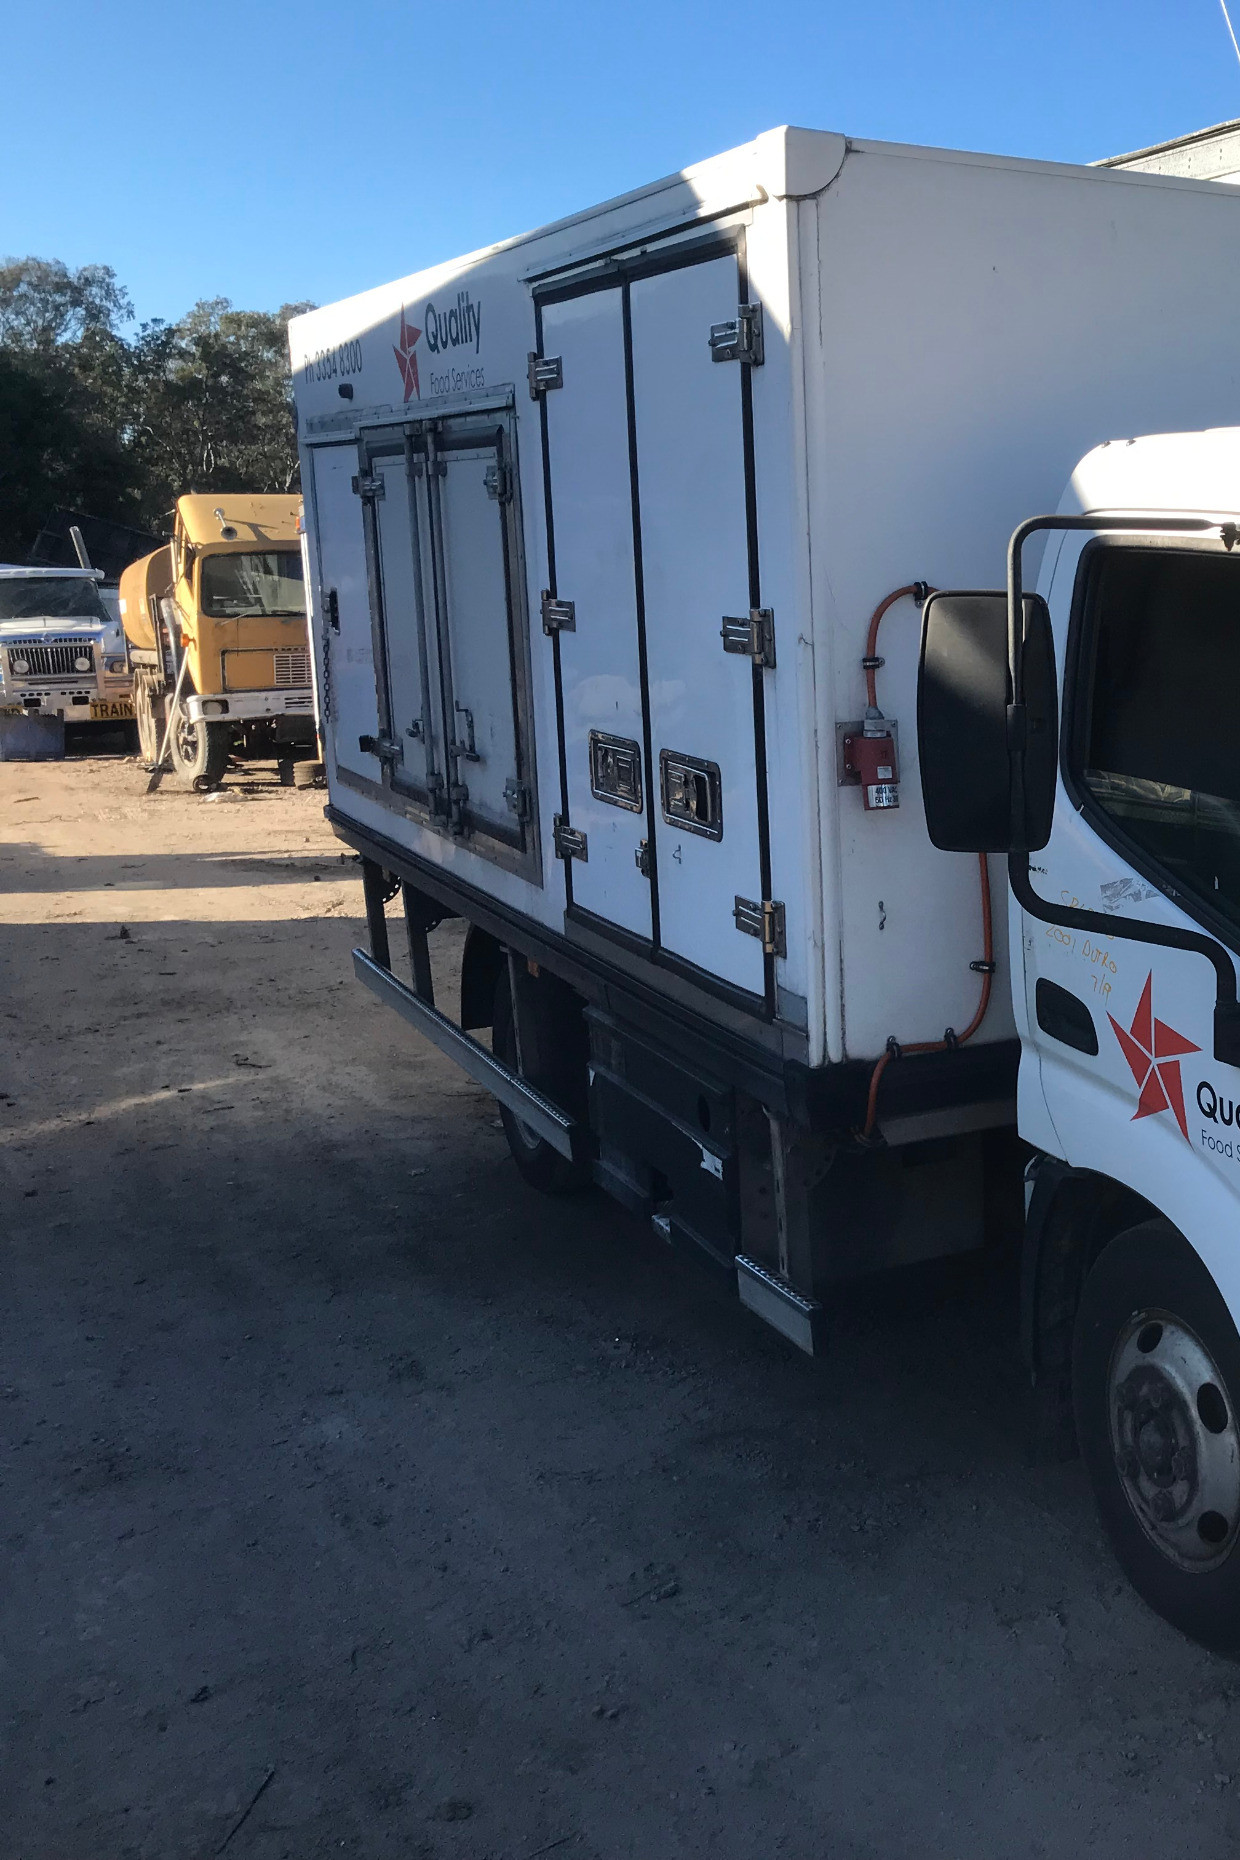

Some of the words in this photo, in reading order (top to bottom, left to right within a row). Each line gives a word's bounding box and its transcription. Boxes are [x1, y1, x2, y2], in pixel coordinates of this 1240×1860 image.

[425, 291, 481, 354] Quality
[338, 339, 363, 377] 8300
[430, 367, 450, 395] Food
[451, 364, 485, 392] Services
[91, 702, 134, 718] TRAIN
[1201, 1129, 1233, 1158] Food
